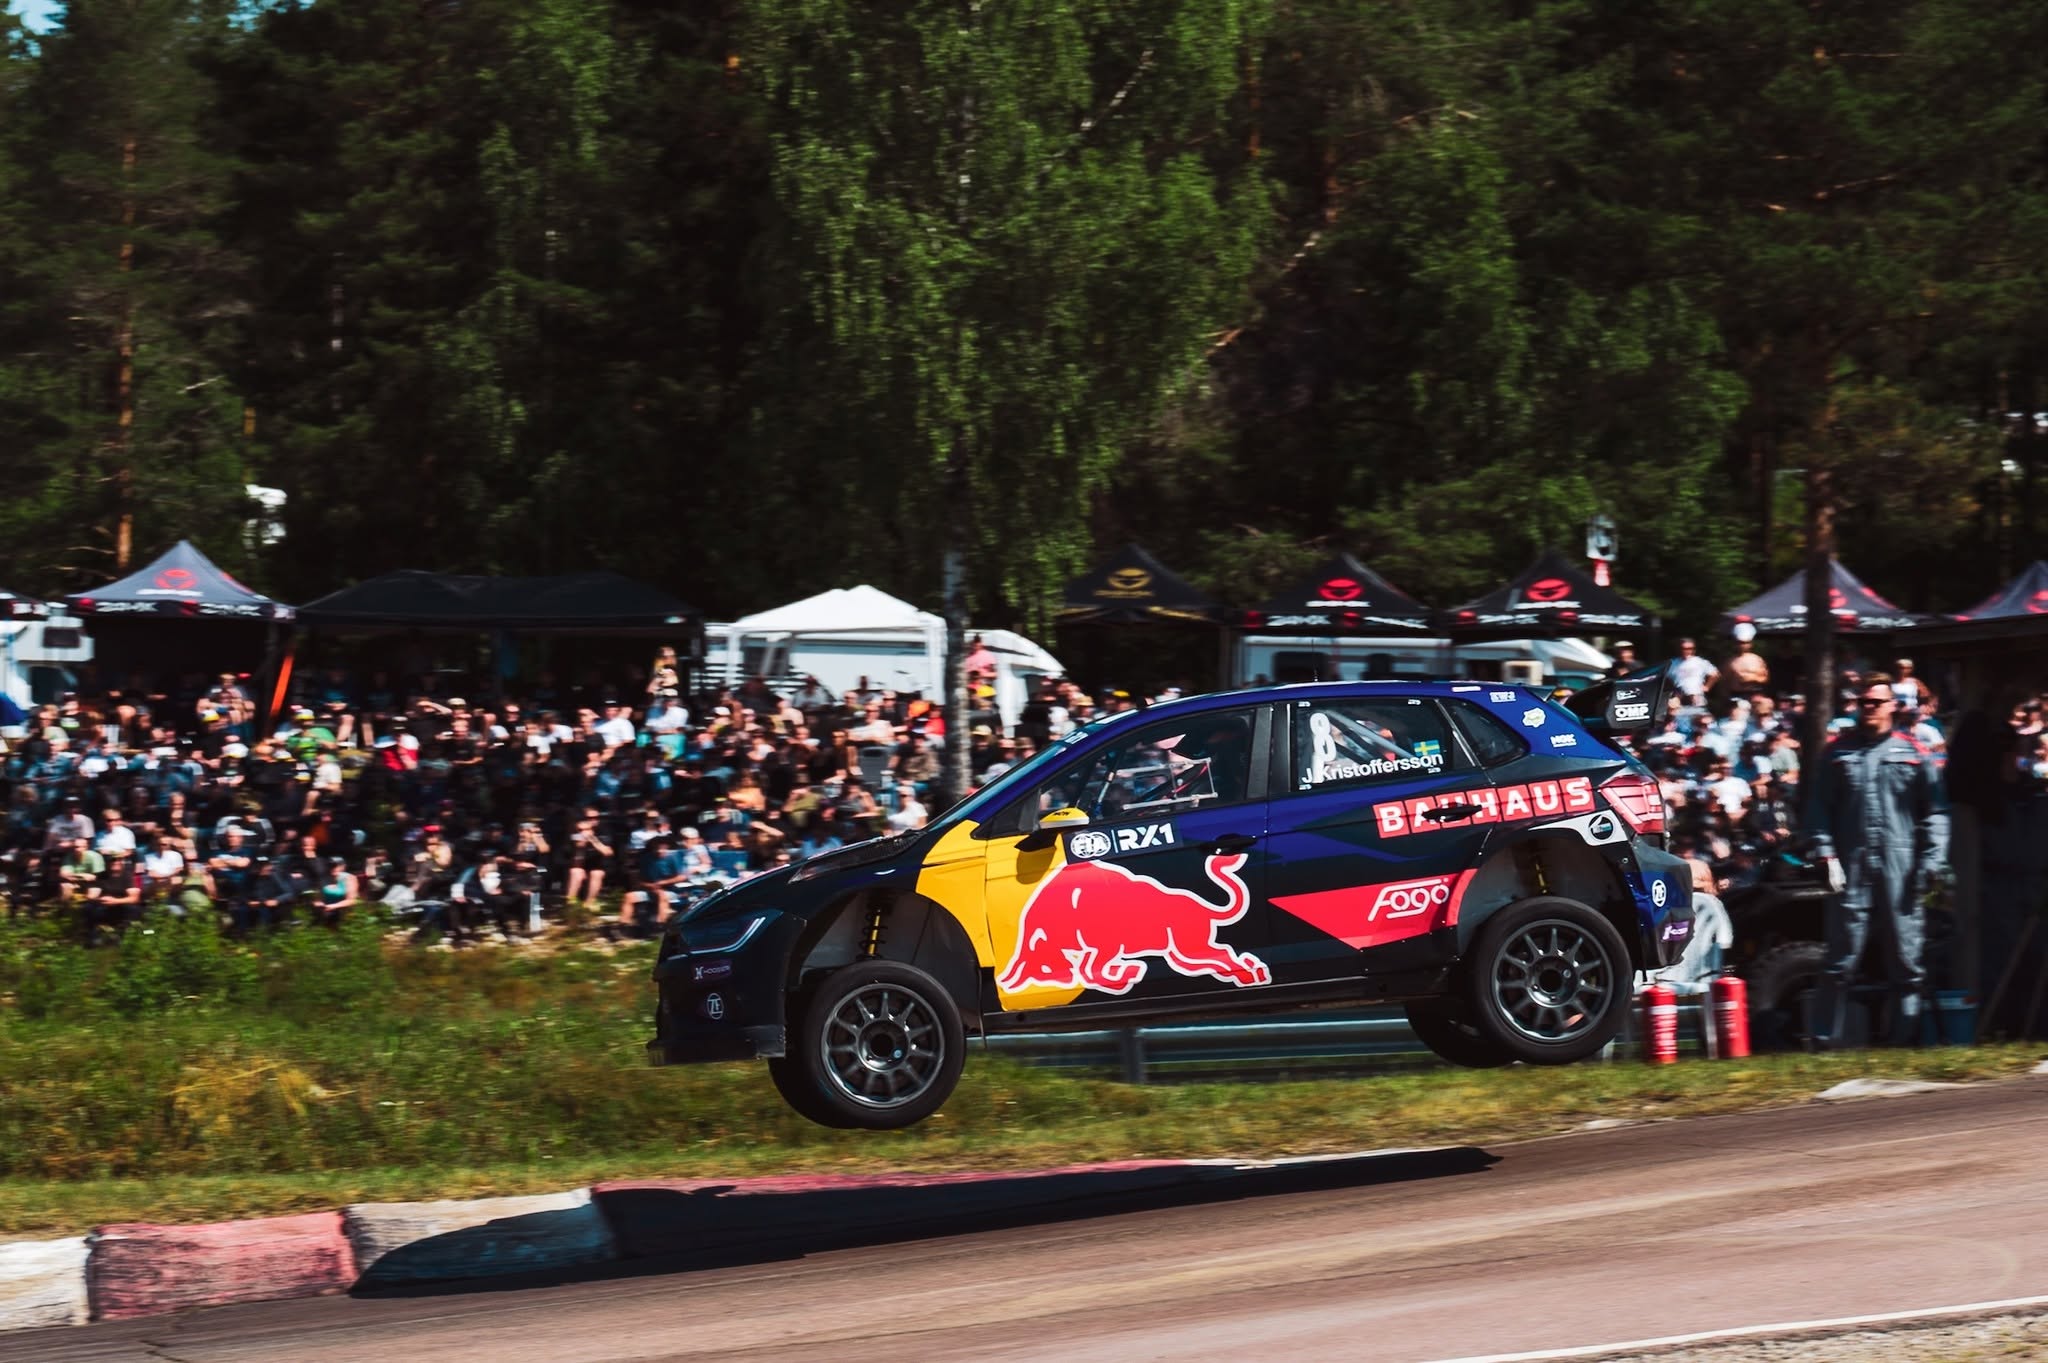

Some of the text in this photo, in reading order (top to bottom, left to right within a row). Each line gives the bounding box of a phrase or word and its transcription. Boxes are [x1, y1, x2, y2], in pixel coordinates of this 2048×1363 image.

[1615, 704, 1649, 719] OMP
[1320, 754, 1444, 782] Kristoffersson
[1118, 823, 1175, 851] RX1
